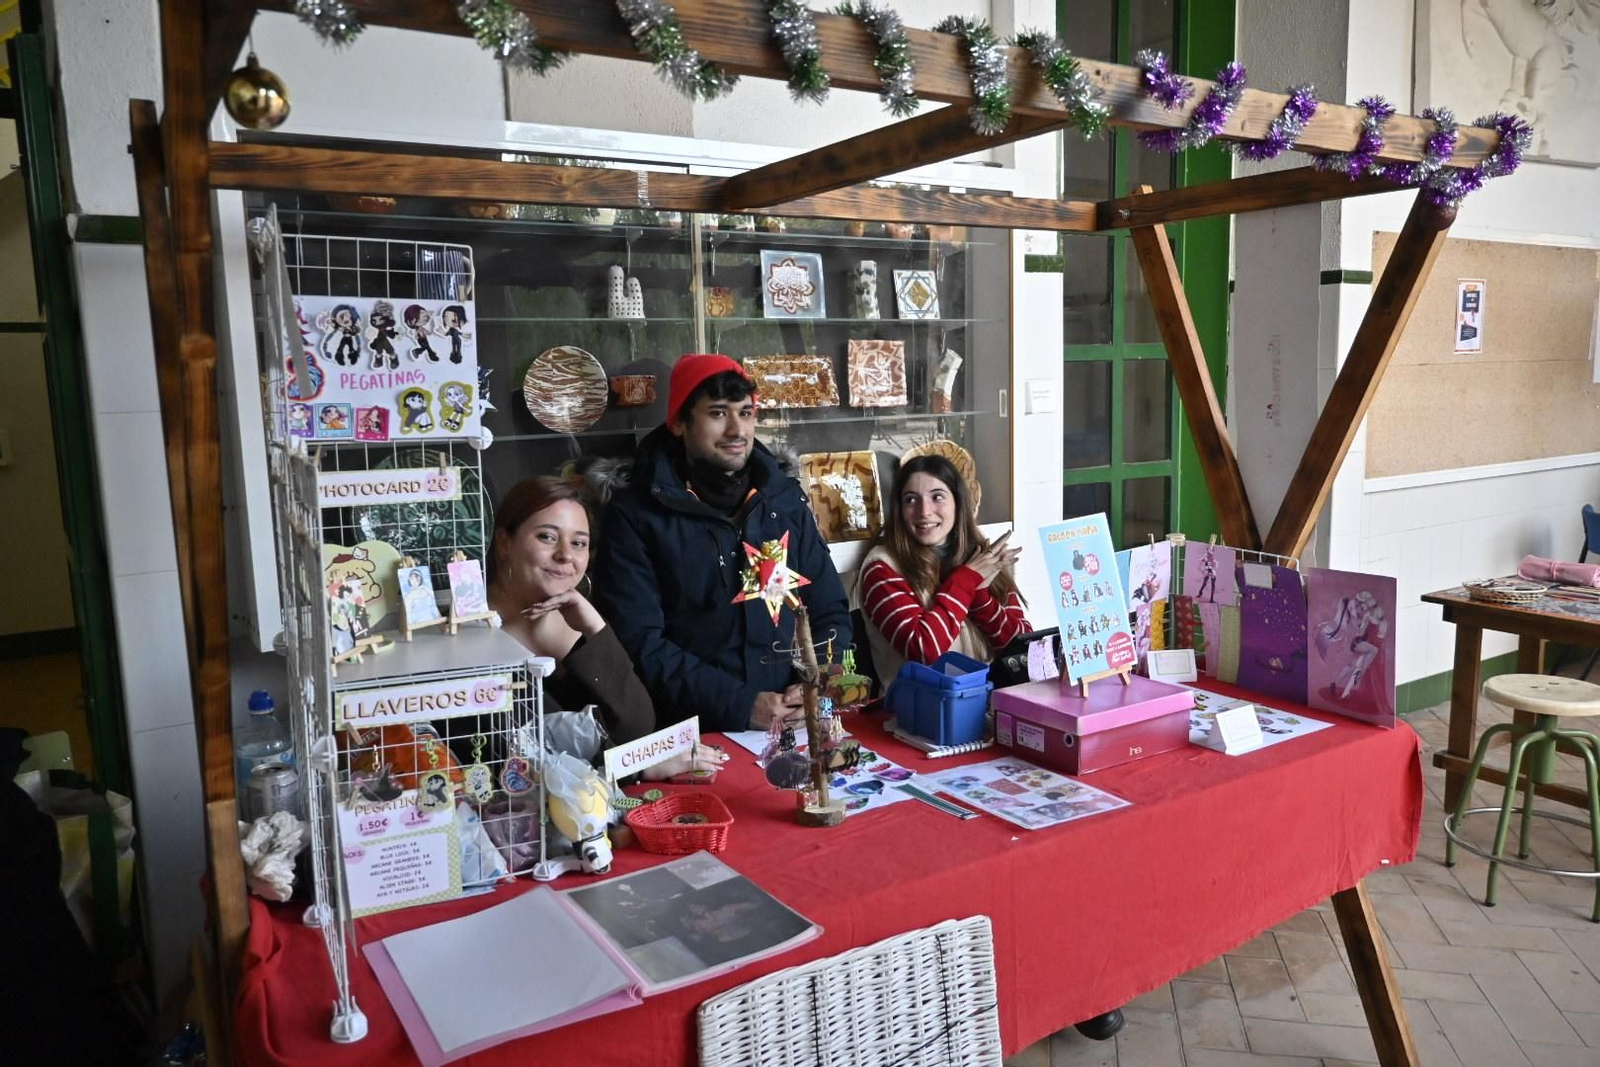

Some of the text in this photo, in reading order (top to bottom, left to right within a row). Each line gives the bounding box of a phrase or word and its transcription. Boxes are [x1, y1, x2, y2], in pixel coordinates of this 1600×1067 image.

[340, 369, 425, 390] PEGATINAS
[319, 478, 448, 498] HOTOCARD 2€
[343, 686, 497, 720] LLAVEROS 6€
[622, 735, 675, 767] CHAPAS
[354, 797, 418, 817] PEGATIN
[359, 818, 388, 832] 1.50€
